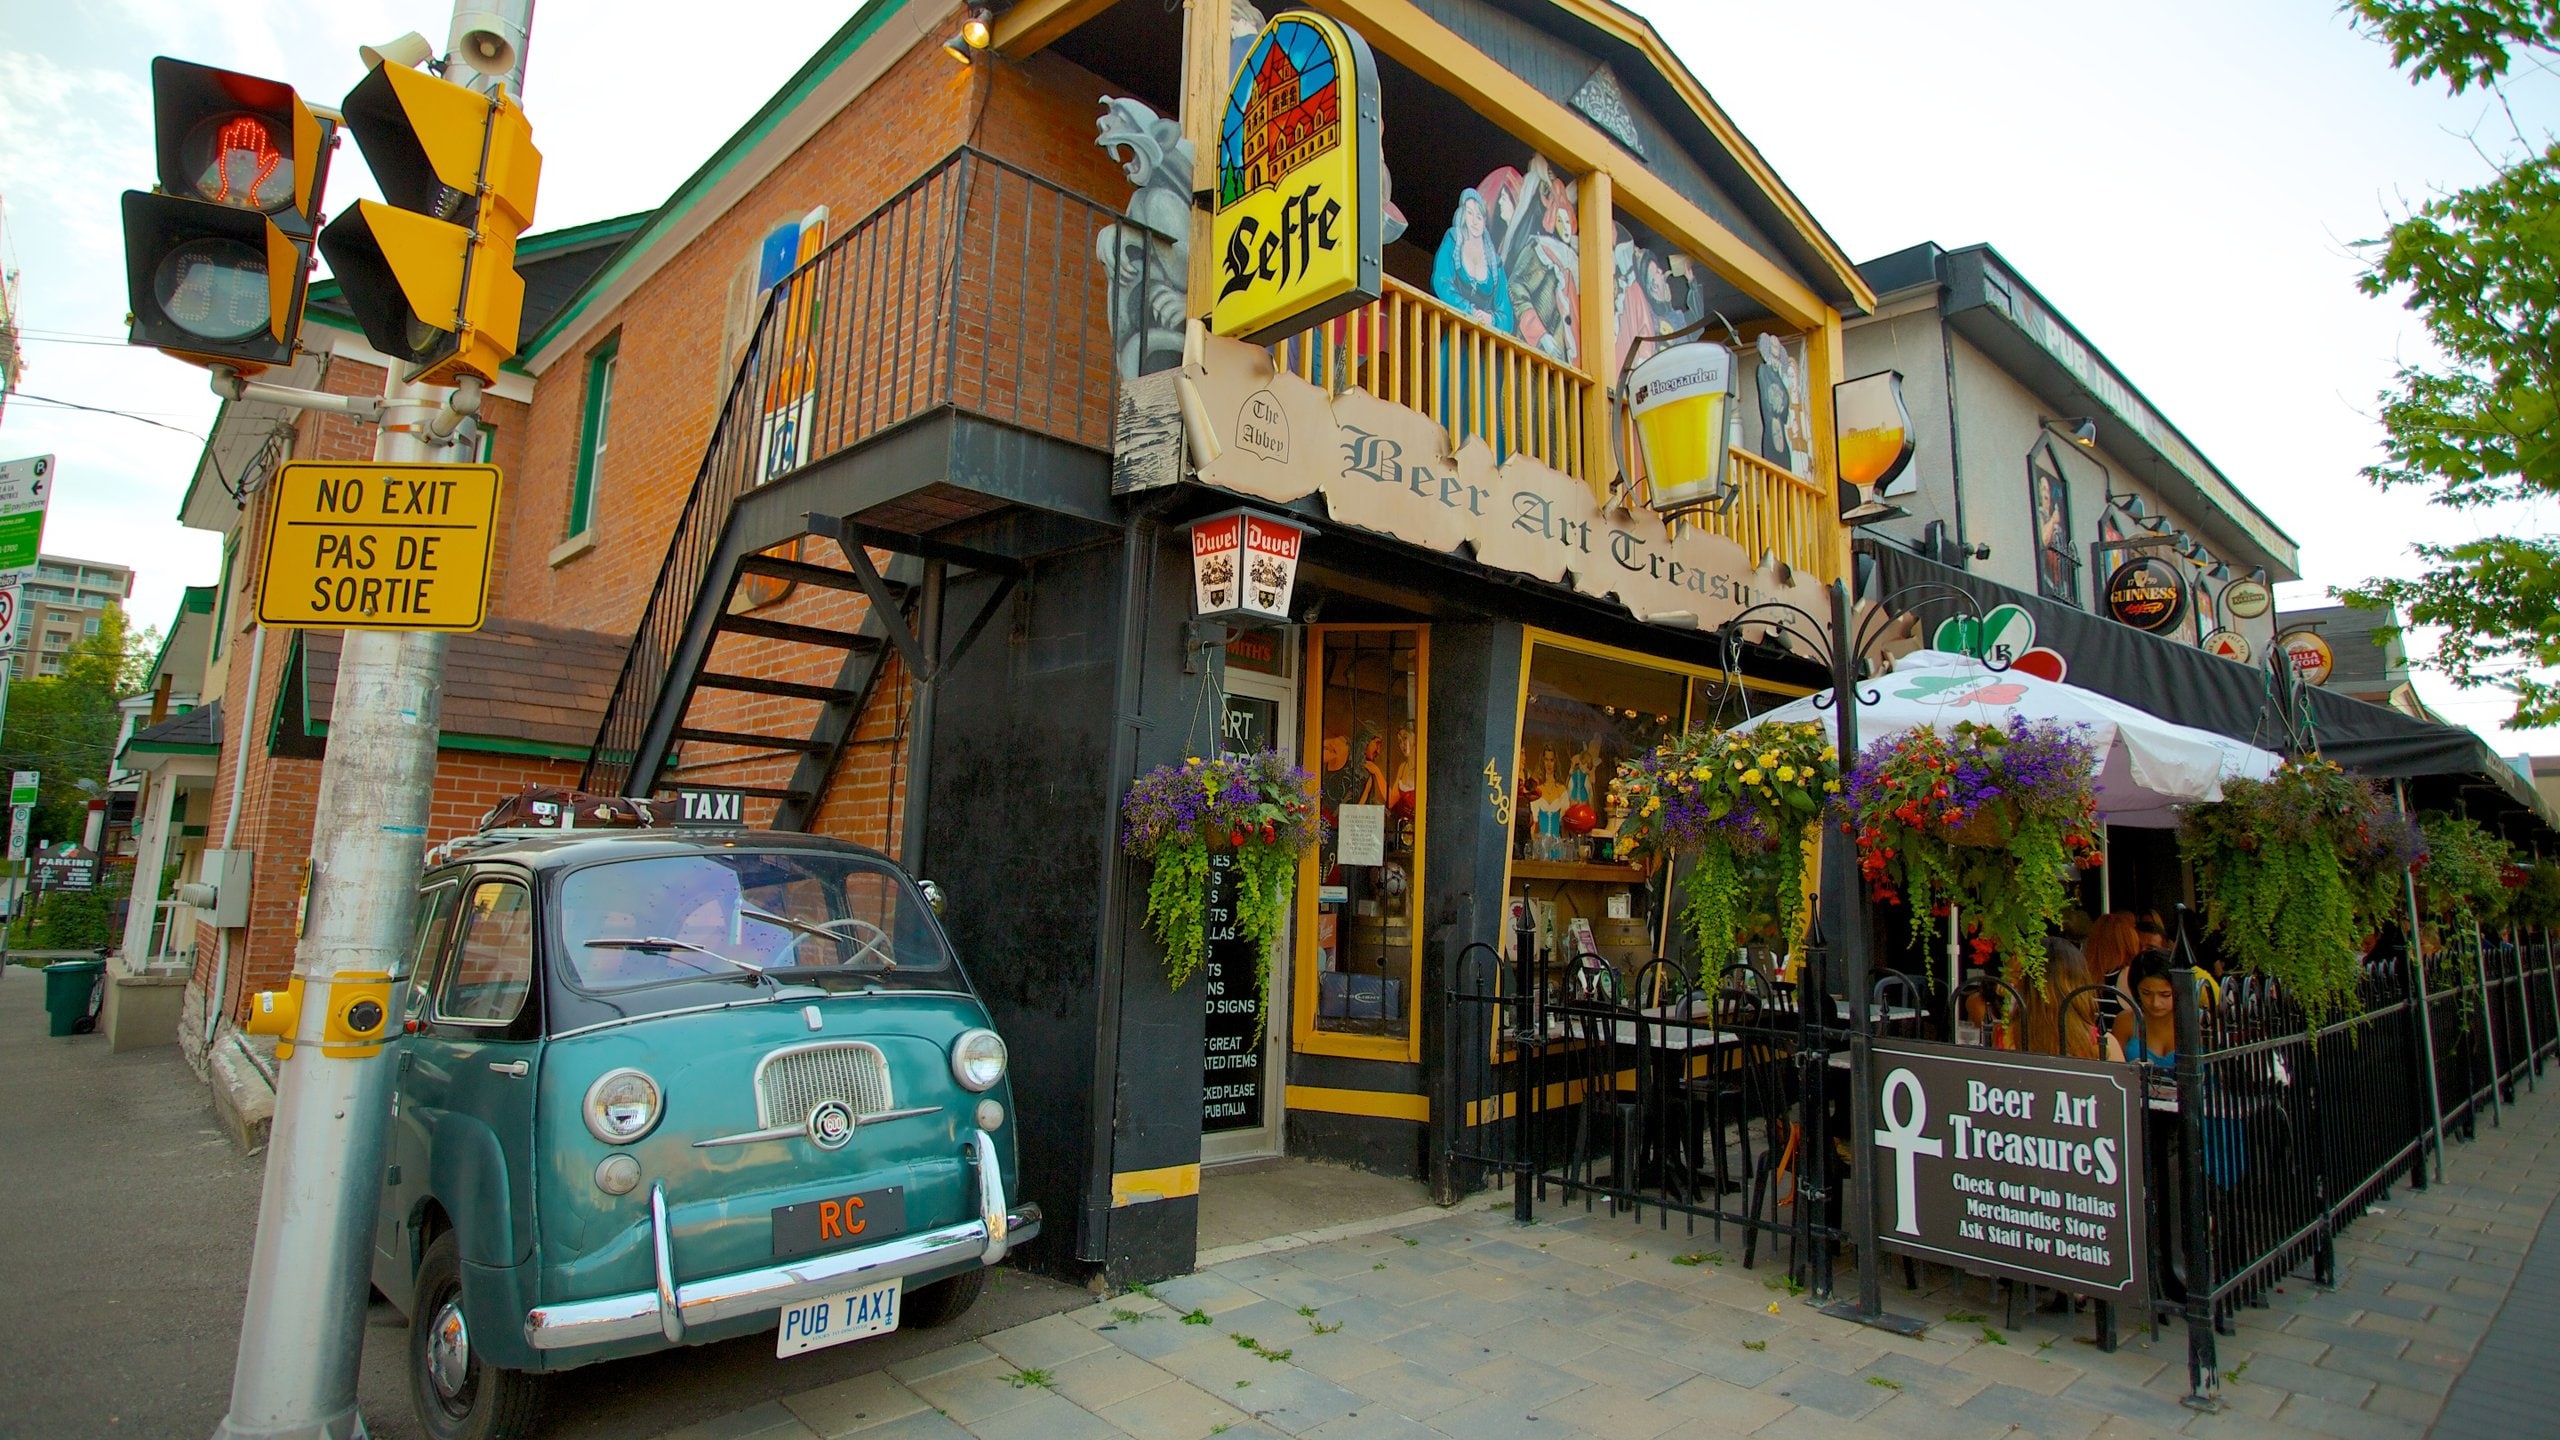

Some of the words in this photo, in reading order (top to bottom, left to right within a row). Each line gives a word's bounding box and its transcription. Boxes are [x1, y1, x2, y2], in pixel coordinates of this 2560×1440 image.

[1217, 184, 1341, 307] Leffe
[1650, 368, 1718, 395] Hoegaarden
[1252, 400, 1279, 425] The
[1242, 424, 1284, 453] Abbey
[316, 479, 364, 513] NO
[381, 480, 457, 515] EXIT
[1196, 525, 1238, 554] Duvel
[1249, 524, 1296, 557] Duvel
[1340, 425, 1490, 517] Beer
[1511, 491, 1592, 554] Art
[1608, 529, 1797, 625] Treasures
[315, 534, 377, 569] PAS
[395, 536, 441, 571] DE
[311, 576, 434, 614] SORTIE
[2110, 587, 2177, 603] GUINNESS
[1220, 709, 1254, 740] ART
[681, 792, 740, 821] TAXI
[1483, 756, 1510, 825] 438
[39, 858, 94, 867] PARKING
[1217, 1000, 1255, 1013] SIGNS
[1209, 1036, 1242, 1051] GREAT
[1227, 1054, 1258, 1069] ITEMS
[1223, 1083, 1256, 1098] PLEASE
[1967, 1079, 2035, 1119] Beer
[2053, 1090, 2098, 1129] Art
[1205, 1104, 1221, 1119] PUB
[1221, 1101, 1246, 1116] ITALIA
[1949, 1113, 2118, 1186] TreasureS
[1952, 1172, 1995, 1197] Check
[1999, 1181, 2025, 1203] Out
[2030, 1186, 2061, 1209] Pub
[2065, 1192, 2117, 1219] Italias
[818, 1195, 867, 1241] RC
[1966, 1198, 2061, 1232] Merchandise
[2065, 1216, 2107, 1241] Store
[1959, 1219, 1984, 1241] Ask
[1987, 1226, 2022, 1249] Staff
[2025, 1232, 2051, 1255] For
[2055, 1240, 2111, 1267] Details
[786, 1303, 830, 1341] PUB
[846, 1288, 896, 1327] TAXI
